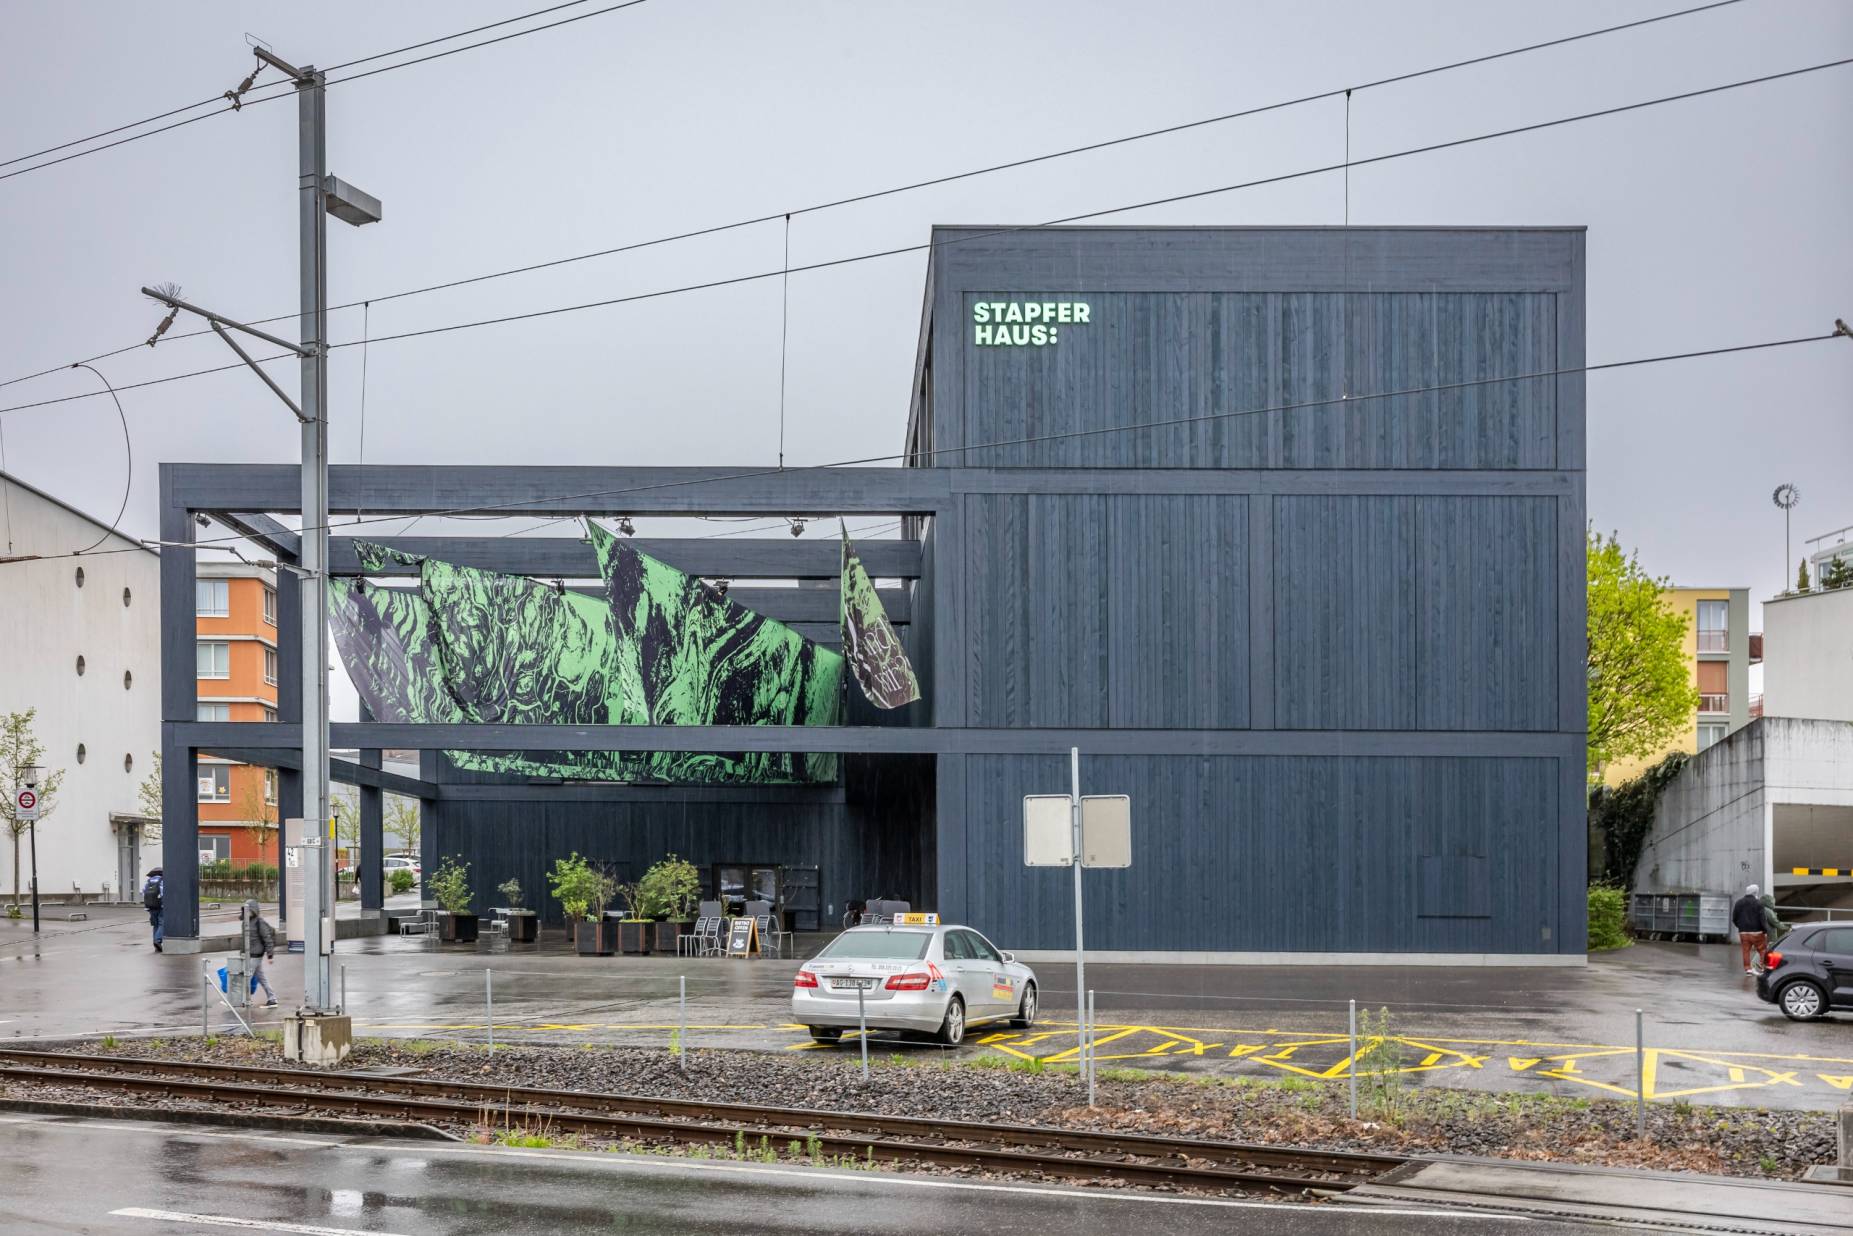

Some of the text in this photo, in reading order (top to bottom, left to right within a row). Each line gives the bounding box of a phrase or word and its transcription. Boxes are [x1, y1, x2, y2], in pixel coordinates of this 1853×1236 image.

[973, 302, 1090, 323] STAPFER
[975, 325, 1058, 346] HAUS:
[1146, 1040, 1298, 1059] TAXI
[1420, 1052, 1582, 1074] TAXI
